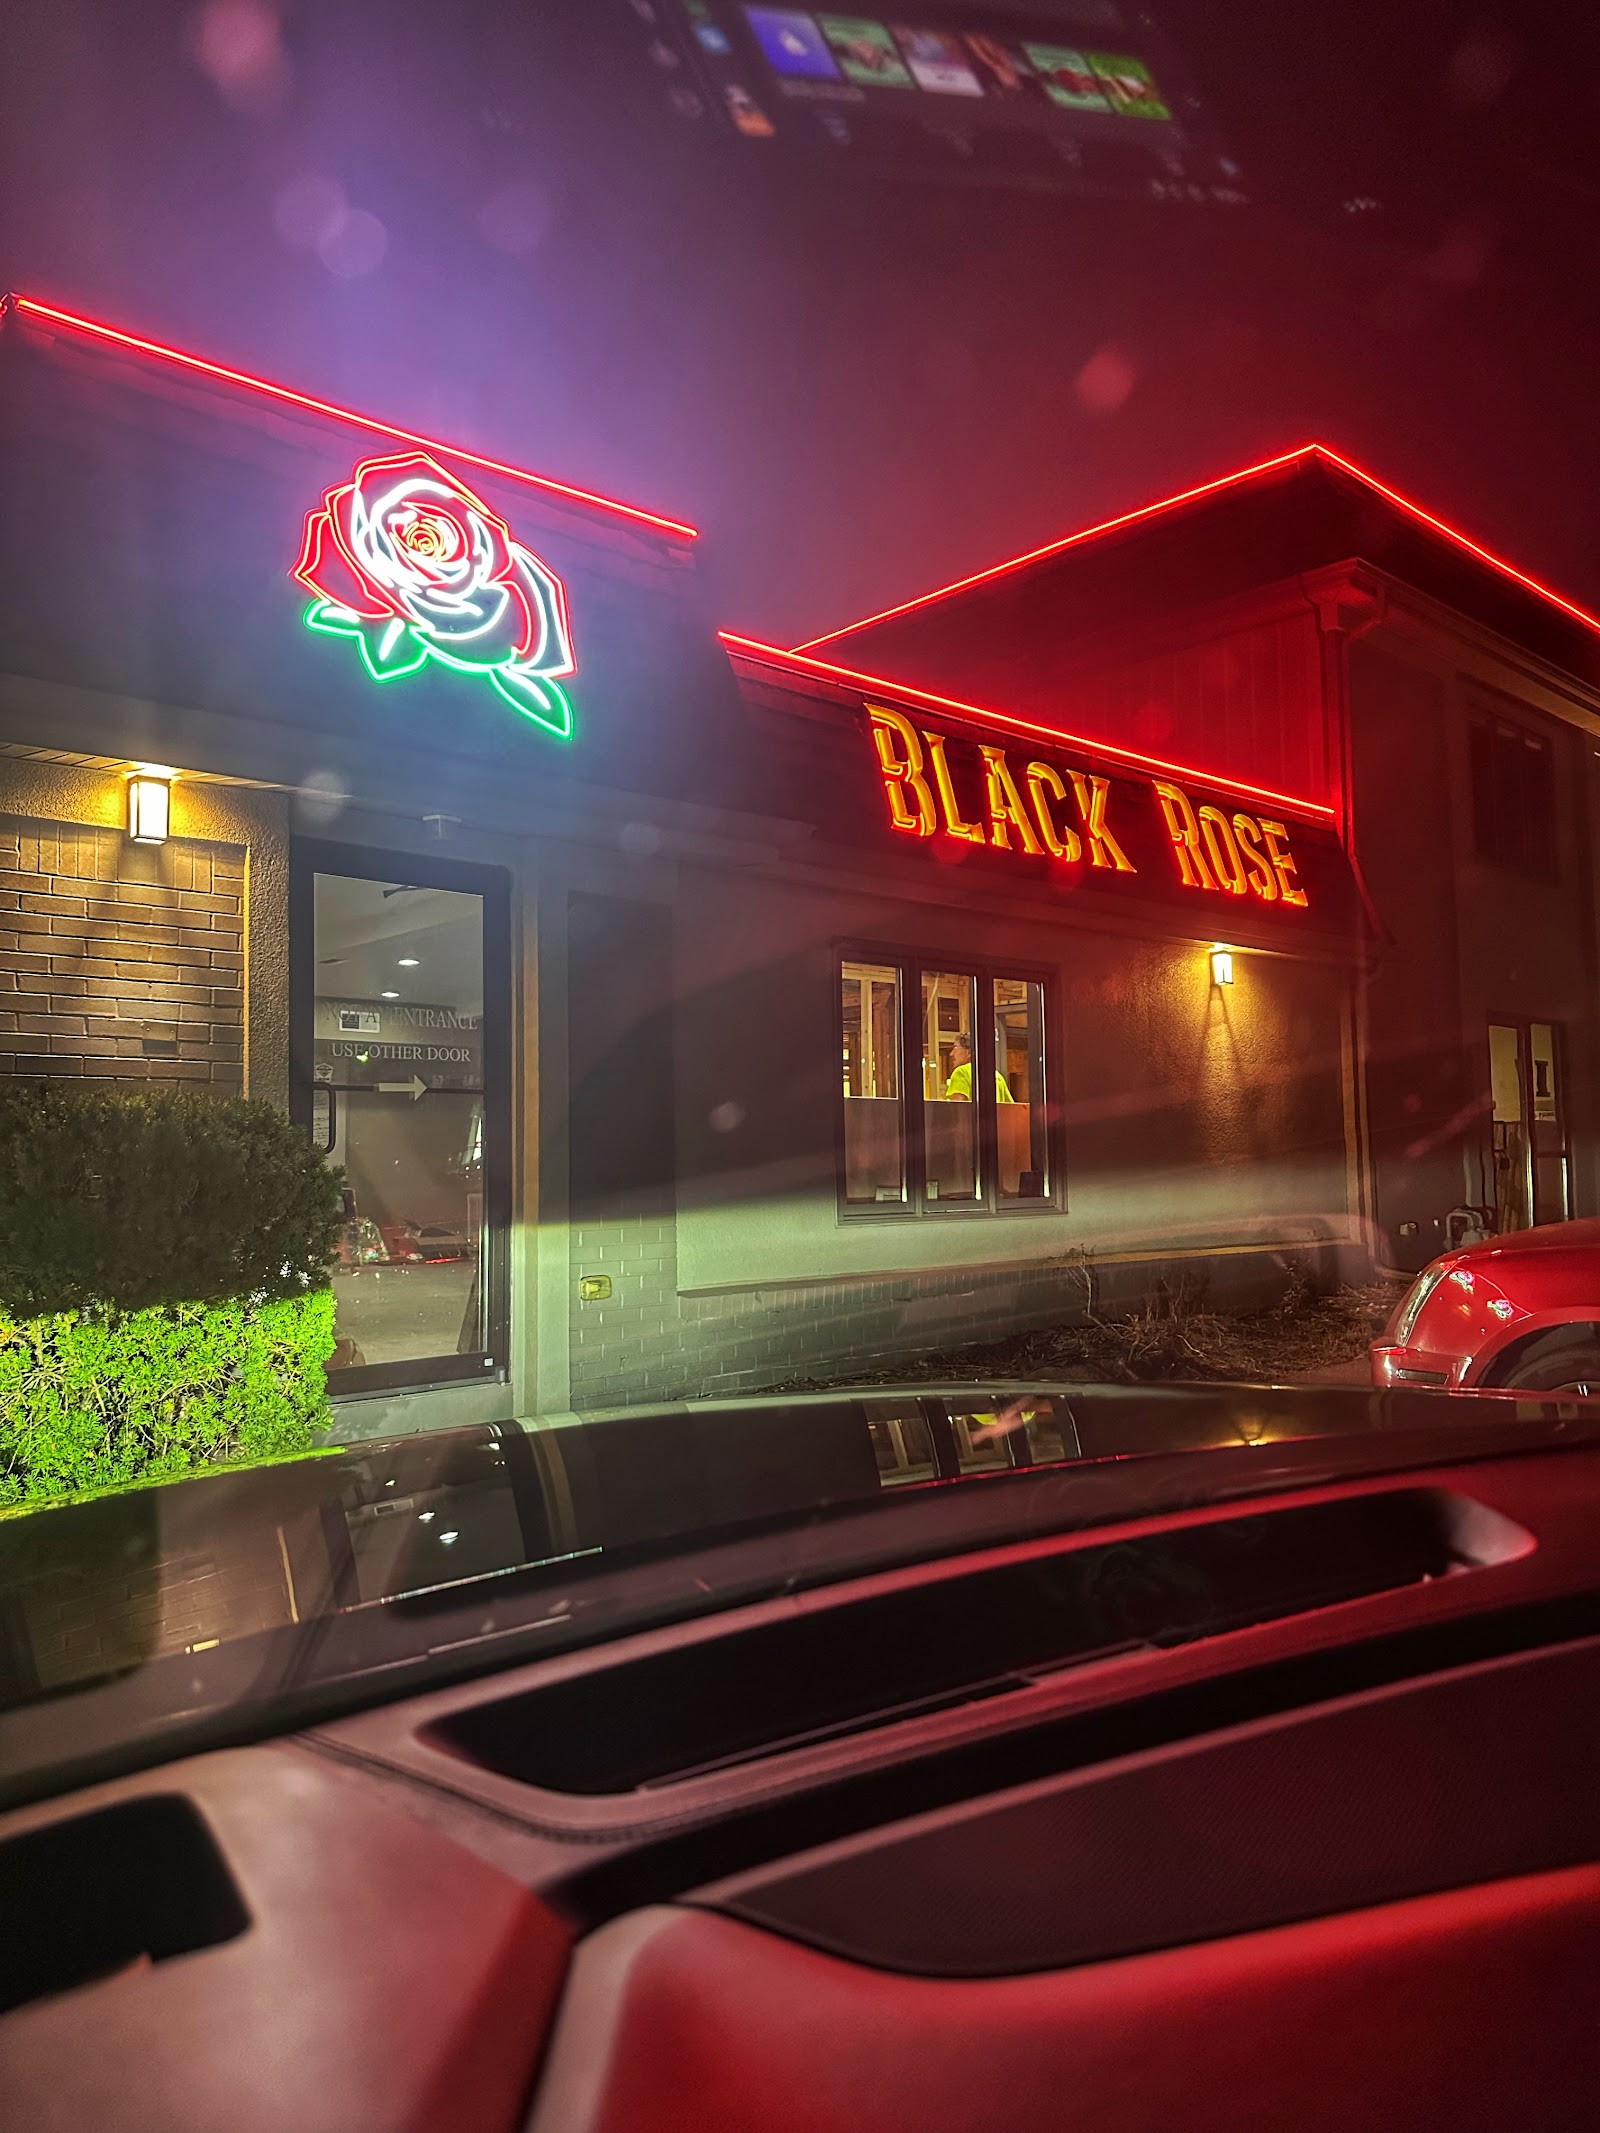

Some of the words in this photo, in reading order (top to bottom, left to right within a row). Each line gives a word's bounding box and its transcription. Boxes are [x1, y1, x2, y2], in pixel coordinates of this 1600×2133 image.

[864, 702, 1137, 873] BLACK
[1152, 780, 1308, 907] ROSE
[393, 1007, 478, 1030] ENTRANCE
[332, 1042, 364, 1058] USE
[368, 1044, 424, 1060] OTHER
[427, 1047, 471, 1062] DOOR
